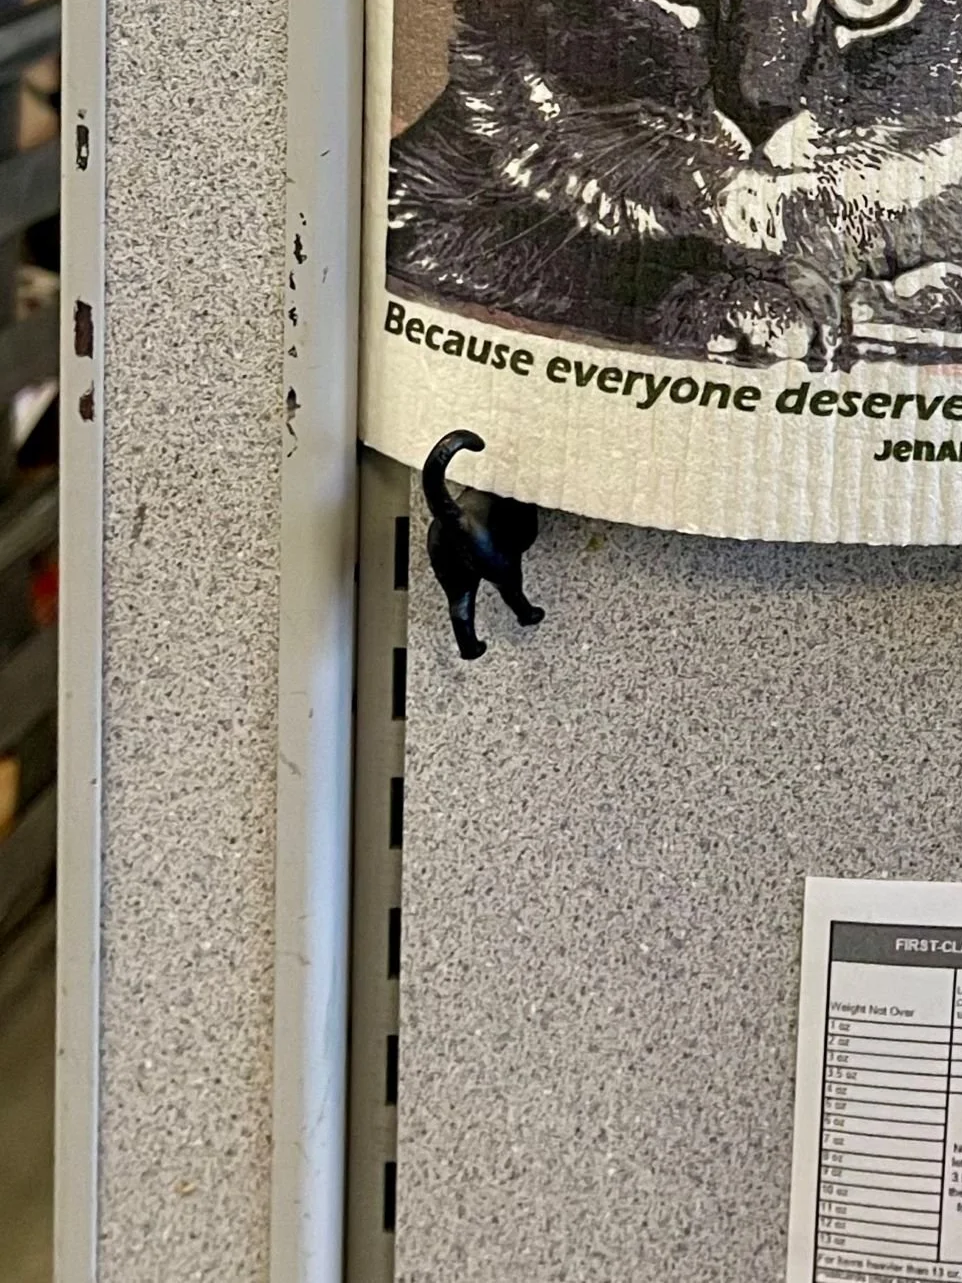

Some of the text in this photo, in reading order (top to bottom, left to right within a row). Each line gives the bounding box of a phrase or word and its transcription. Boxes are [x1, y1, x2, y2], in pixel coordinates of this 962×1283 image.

[384, 301, 535, 376] Because
[546, 355, 762, 412] everyone
[831, 1001, 915, 1018] Weight Not Over
